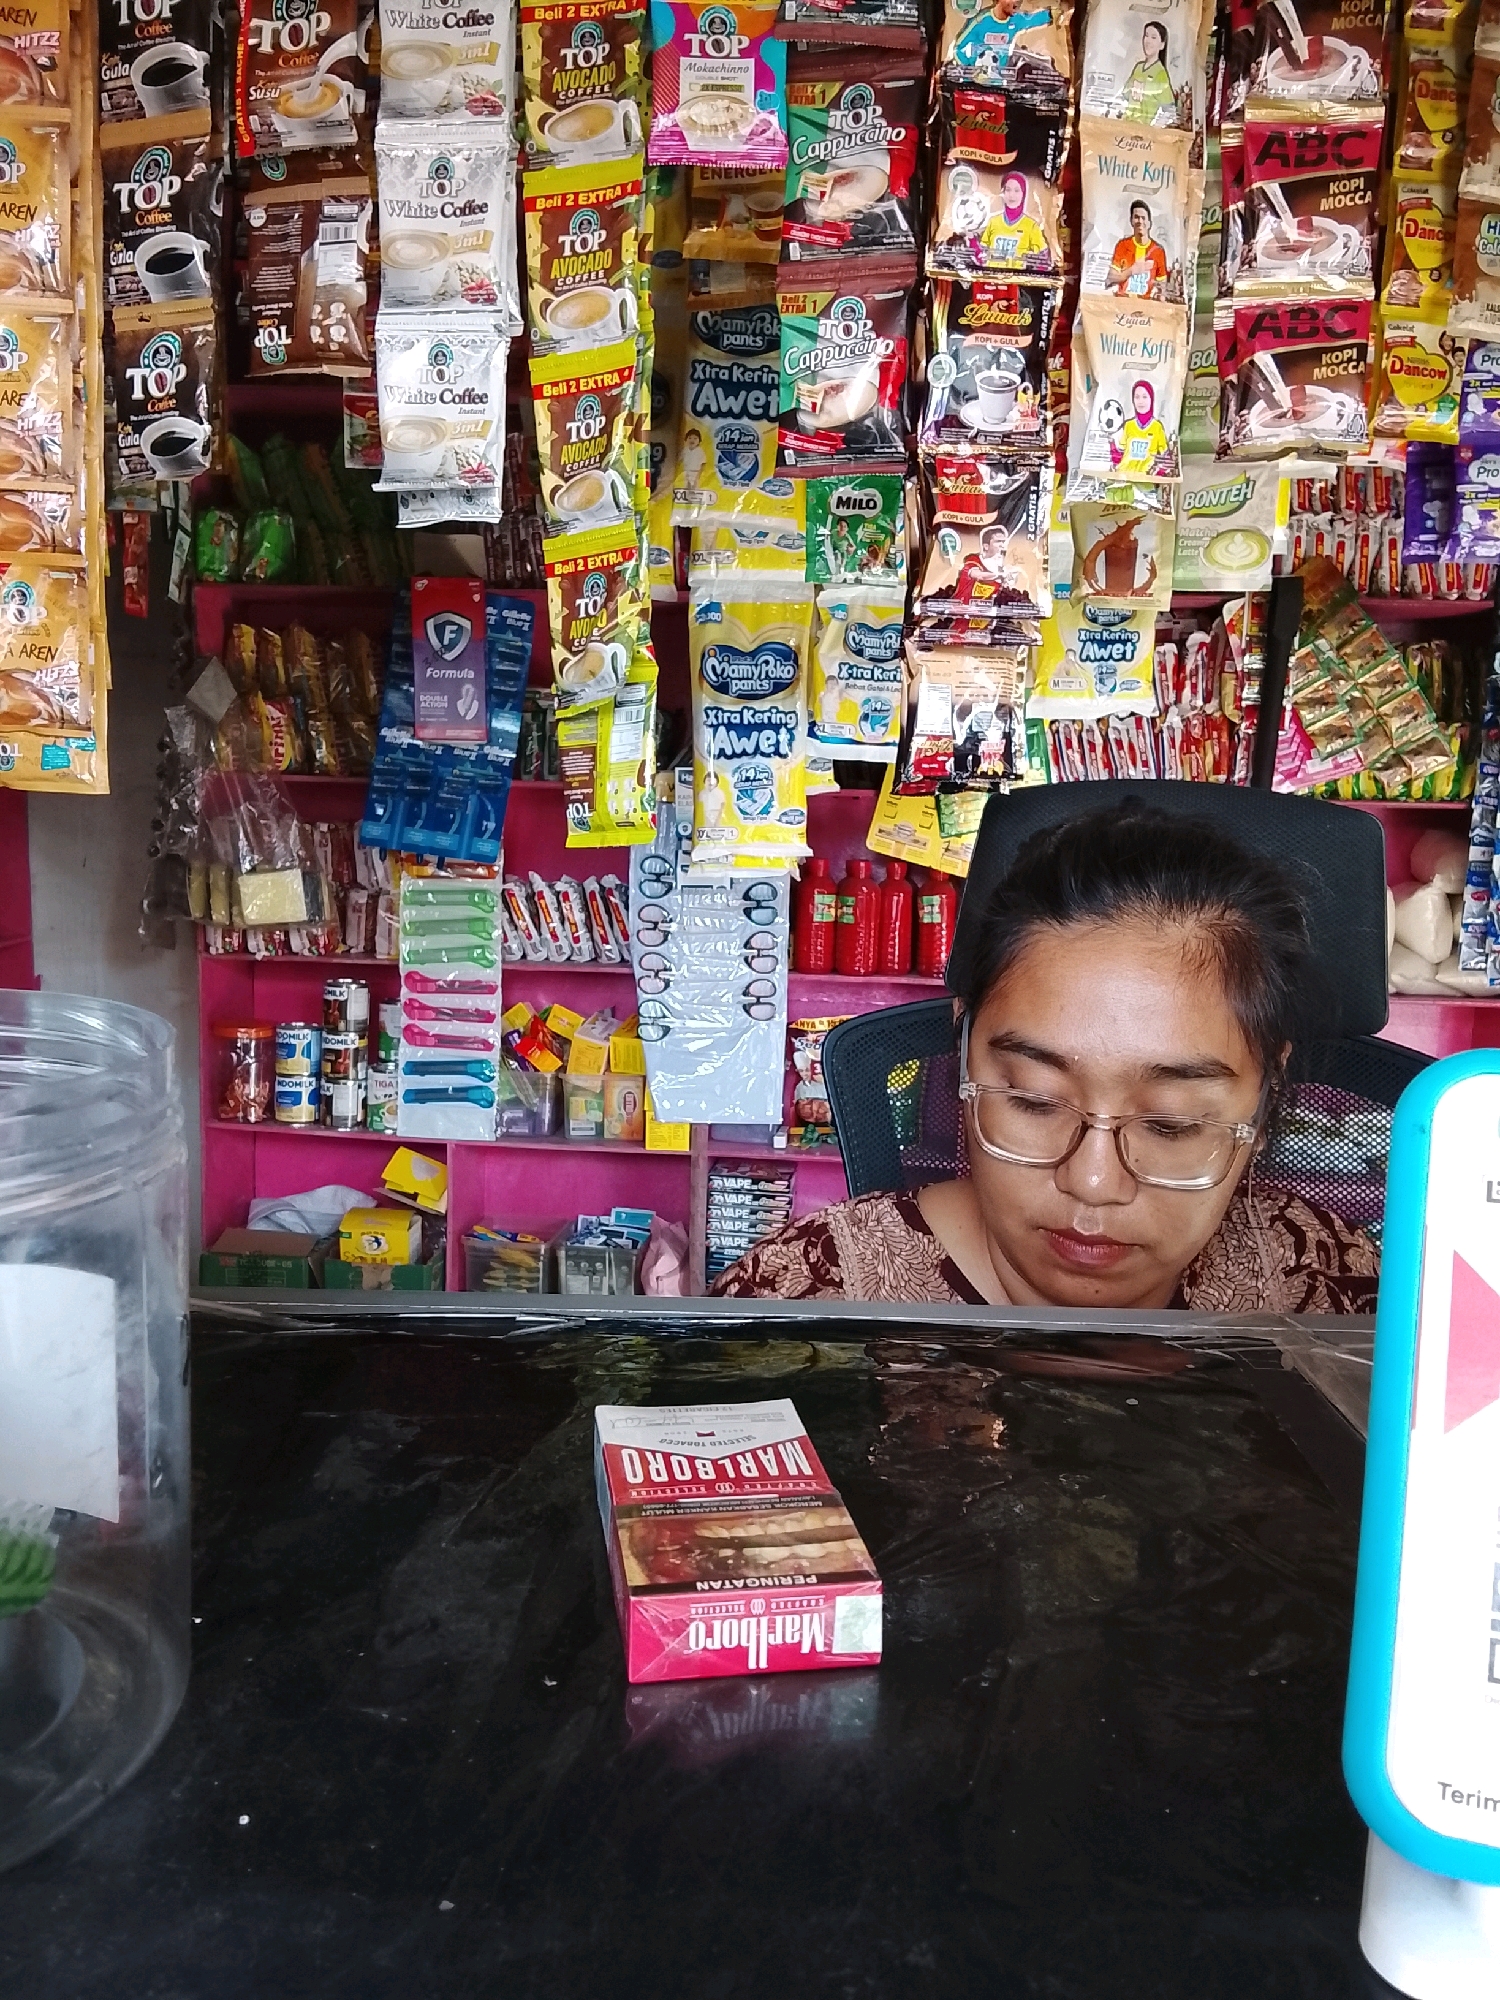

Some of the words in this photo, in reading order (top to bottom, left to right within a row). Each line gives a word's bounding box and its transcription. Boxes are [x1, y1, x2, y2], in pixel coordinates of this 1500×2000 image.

[534, 7, 562, 20] Beli
[566, 6, 575, 18] 2
[580, 0, 627, 16] EXTRA
[1341, 0, 1374, 13] KOPI
[385, 10, 440, 29] White
[442, 10, 495, 28] Coffee
[1331, 15, 1383, 30] MOCCA
[134, 21, 173, 38] Coffee
[249, 12, 331, 54] TOP
[463, 29, 491, 38] Instant
[15, 31, 60, 48] HITZZ
[684, 33, 750, 58] TOP
[457, 42, 490, 59] 3in1
[560, 42, 611, 70] TOP
[278, 52, 320, 68] Coffee
[684, 63, 749, 74] Mokachinno
[101, 63, 130, 81] Gula
[552, 61, 616, 93] AVOCADO
[249, 86, 282, 101] Susu
[559, 84, 611, 100] COFFEE
[235, 99, 250, 143] GRATIS
[829, 105, 886, 130] TOP
[793, 124, 906, 164] Cappuccino
[1253, 131, 1367, 168] ABC
[959, 149, 976, 158] KOPI
[983, 154, 1003, 163] GULA
[1044, 138, 1056, 178] GRATIS
[1098, 155, 1138, 179] White
[113, 175, 181, 214] TOP
[415, 179, 466, 198] TOP
[1329, 178, 1365, 195] KOPI
[535, 195, 562, 211] Beli
[565, 194, 574, 206] 2
[578, 185, 622, 206] EXTRA
[626, 183, 633, 193] 1
[1319, 191, 1372, 211] MOCCA
[135, 209, 173, 226] Coffee
[384, 199, 438, 219] White
[440, 200, 489, 218] Coffee
[459, 218, 485, 227] Instant
[454, 236, 484, 249] 3in1
[557, 229, 607, 257] TOP
[550, 248, 613, 280] AVOCADO
[557, 270, 605, 287] COFFEE
[958, 303, 1033, 327] Luwak
[1039, 303, 1051, 339] GRATIS
[1249, 304, 1359, 339] ABC
[254, 325, 292, 347] TOP
[820, 319, 876, 340] TOP
[722, 334, 765, 348] pants
[975, 334, 991, 344] KOPI
[1000, 336, 1019, 346] GULA
[1100, 333, 1137, 356] White
[784, 336, 894, 375] Cappuccino
[1321, 347, 1358, 365] KOPI
[417, 365, 463, 384] TOP
[692, 362, 729, 380] Xtra
[1312, 362, 1365, 380] MOCCA
[1389, 354, 1447, 380] Dancow
[125, 363, 188, 400] TOP
[542, 381, 567, 398] Beli
[569, 380, 577, 393] 2
[579, 371, 621, 392] EXTRA
[385, 385, 437, 405] White
[438, 388, 489, 405] Coffee
[696, 382, 779, 418] Awet
[147, 397, 176, 412] Coffee
[458, 407, 485, 415] Instant
[452, 422, 483, 434] 3in1
[566, 415, 606, 443] TOP
[118, 433, 140, 447] Gula
[560, 433, 607, 466] AVOCADO
[566, 455, 601, 472] COFFEE
[836, 495, 877, 511] MILO
[1183, 480, 1254, 512] BONTEH
[942, 512, 959, 521] KOPI
[964, 515, 984, 523] GULA
[1028, 493, 1037, 531] GRATIS
[1028, 533, 1035, 541] 2
[1180, 527, 1218, 538] Matcha
[1178, 547, 1199, 556] Latte
[1179, 538, 1210, 549] Creamy
[554, 560, 575, 574] Beli
[576, 558, 584, 571] 2
[588, 550, 623, 570] EXTRA
[443, 626, 457, 645] F
[1078, 629, 1100, 641] Xtra
[1102, 629, 1139, 643] Kering
[19, 643, 58, 662] AREN
[865, 646, 892, 658] pants
[1080, 642, 1134, 661] Awet
[426, 667, 474, 679] Formula
[705, 653, 795, 683] MamyPoko
[731, 676, 770, 691] pants
[1052, 679, 1060, 688] M
[420, 701, 448, 709] ACTION
[705, 709, 741, 725] Xtra
[746, 709, 796, 728] Kering
[713, 728, 791, 757] Awet
[566, 801, 593, 818] TOP
[375, 1080, 394, 1088] TIGA
[722, 1177, 752, 1190] VAPE
[724, 1192, 754, 1205] VAPE
[721, 1207, 750, 1219] VAPE
[721, 1220, 749, 1232] VAPE
[720, 1236, 749, 1248] VAPE
[658, 1438, 707, 1447] TOBACCO
[709, 1434, 757, 1447] SELECTED
[620, 1440, 814, 1484] MARLBORO
[696, 1575, 818, 1591] PERINGATAN
[688, 1612, 826, 1670] Marlboro
